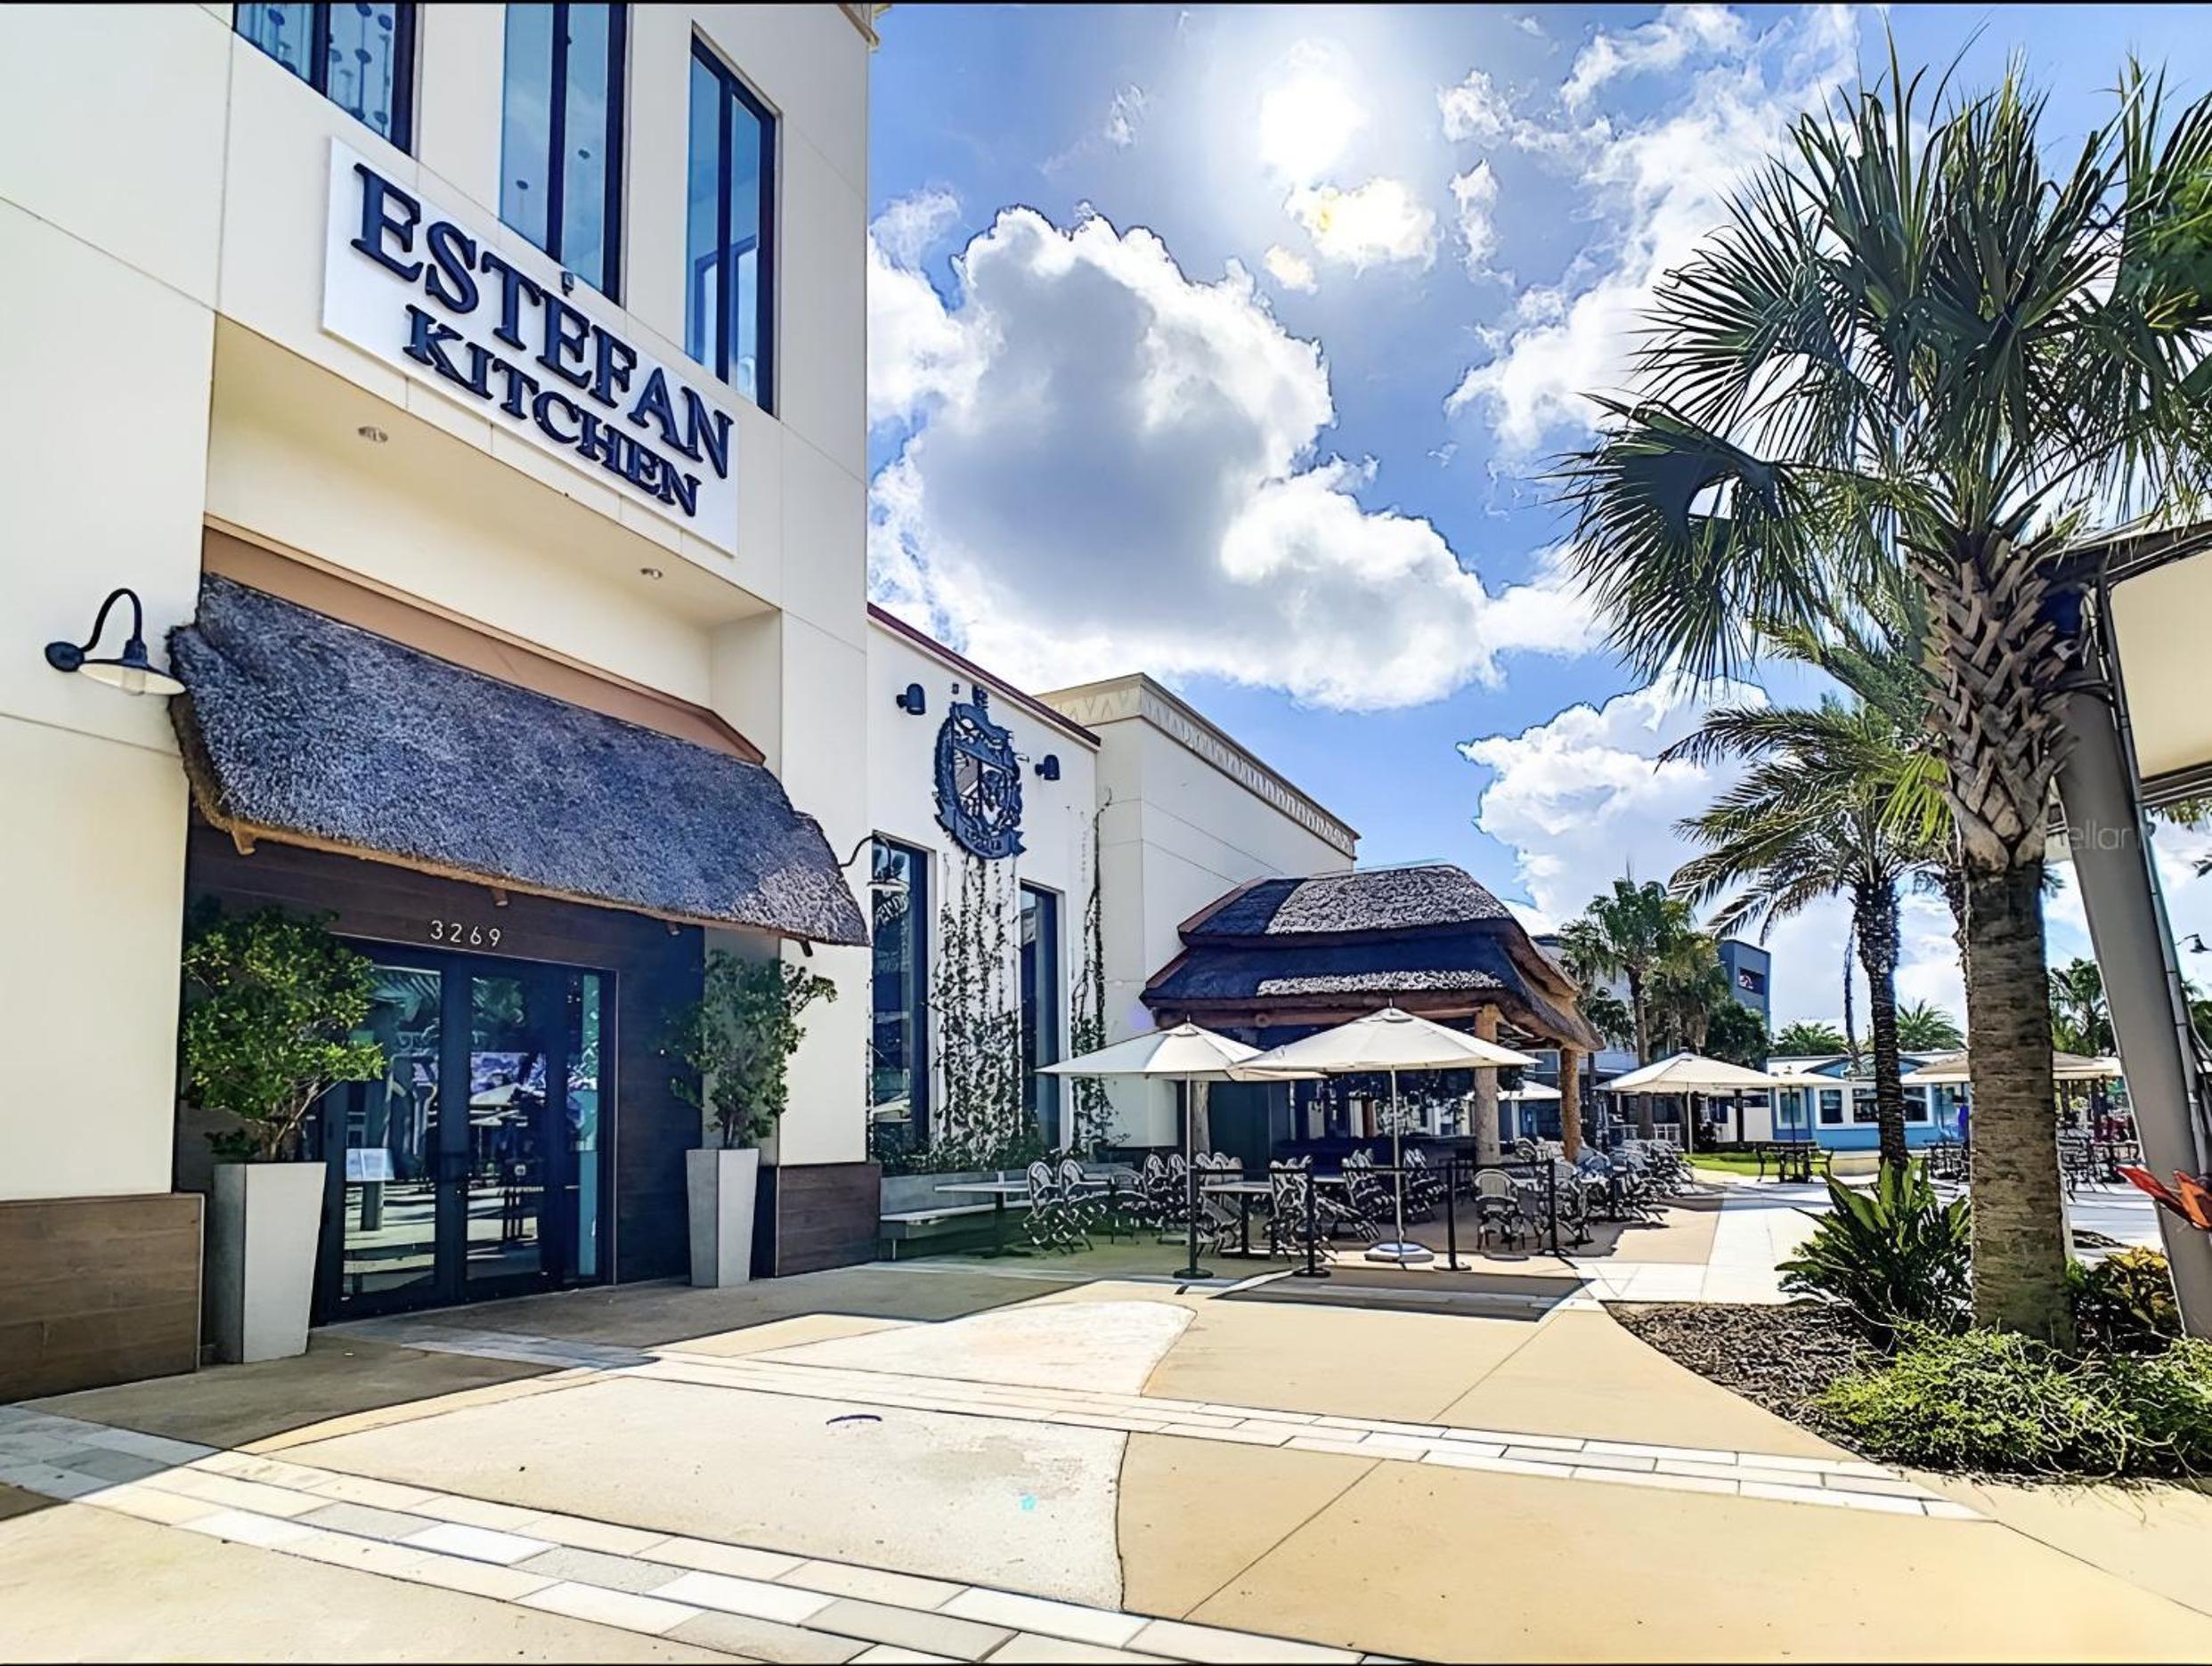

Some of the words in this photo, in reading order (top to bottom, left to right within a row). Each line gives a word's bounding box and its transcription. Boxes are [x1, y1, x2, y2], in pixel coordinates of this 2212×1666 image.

[351, 162, 734, 480] ESTEFAN
[403, 304, 702, 517] KITCHEN
[429, 919, 501, 947] 3269
